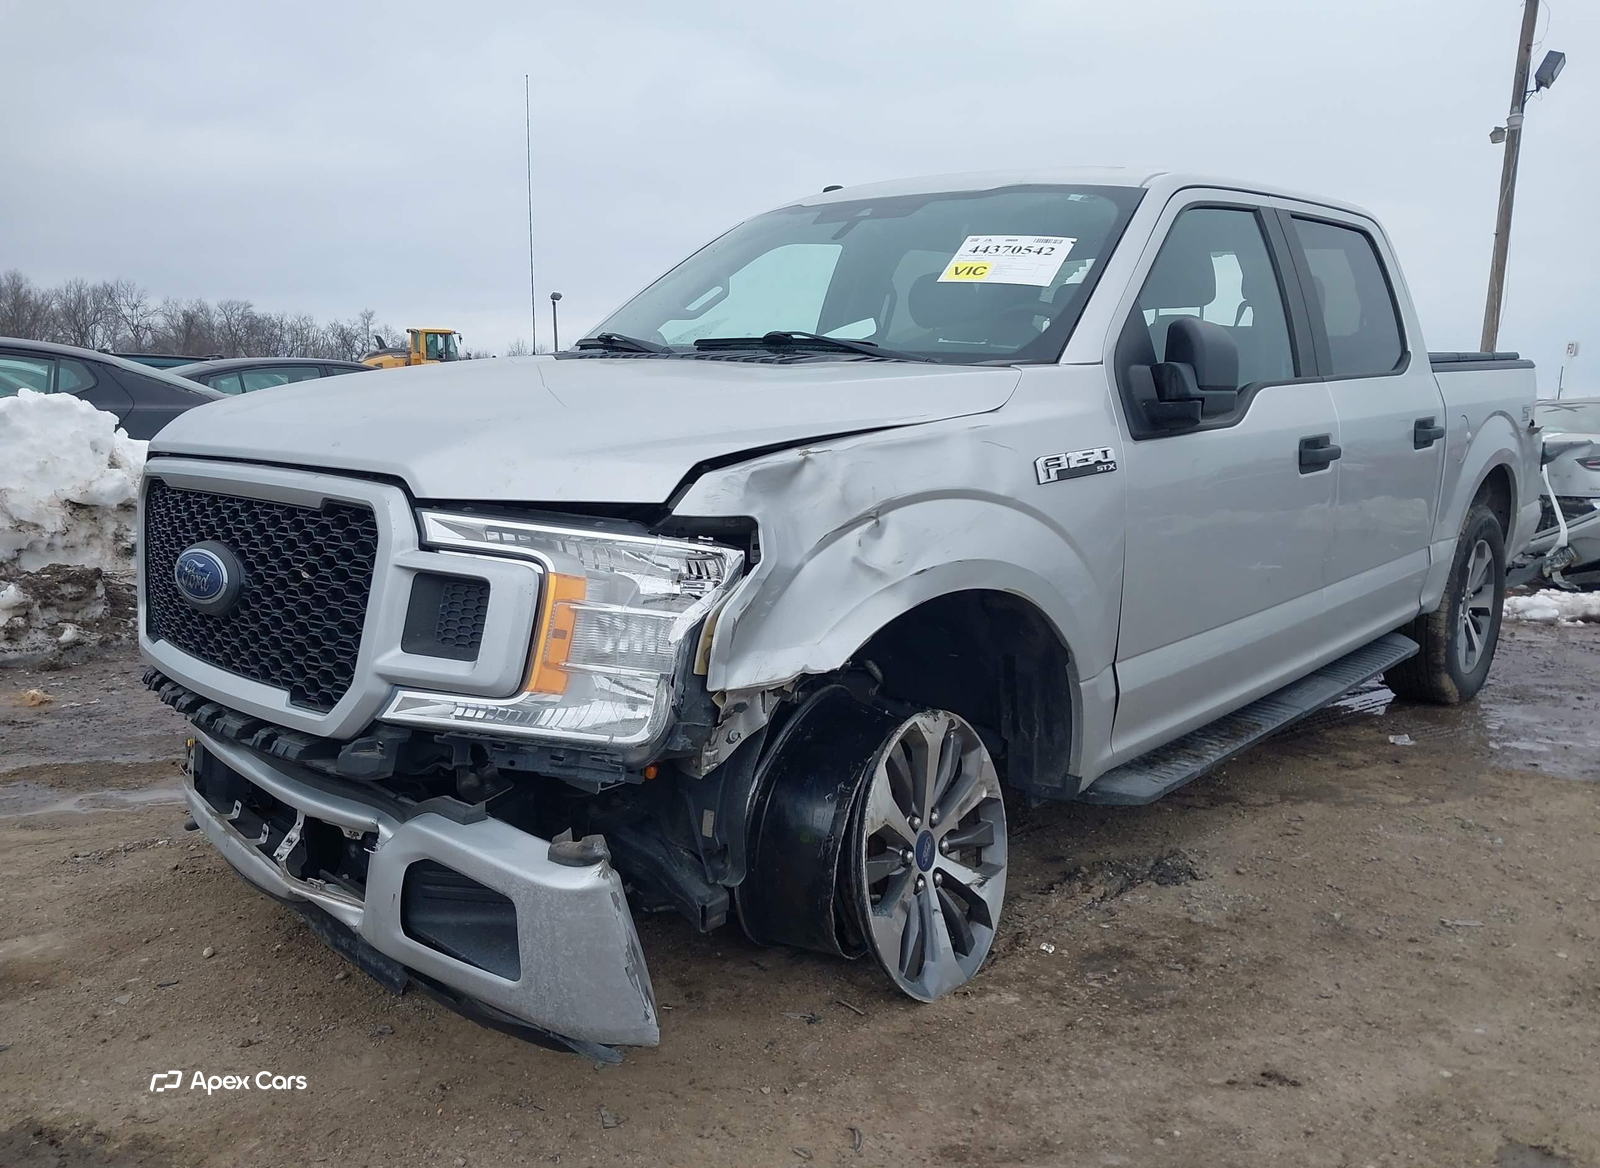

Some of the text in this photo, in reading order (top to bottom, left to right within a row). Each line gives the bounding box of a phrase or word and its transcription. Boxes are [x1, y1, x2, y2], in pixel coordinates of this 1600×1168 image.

[968, 245, 1055, 256] 44370542
[954, 266, 988, 276] VIC
[1096, 463, 1116, 472] STX
[182, 559, 211, 592] Ford
